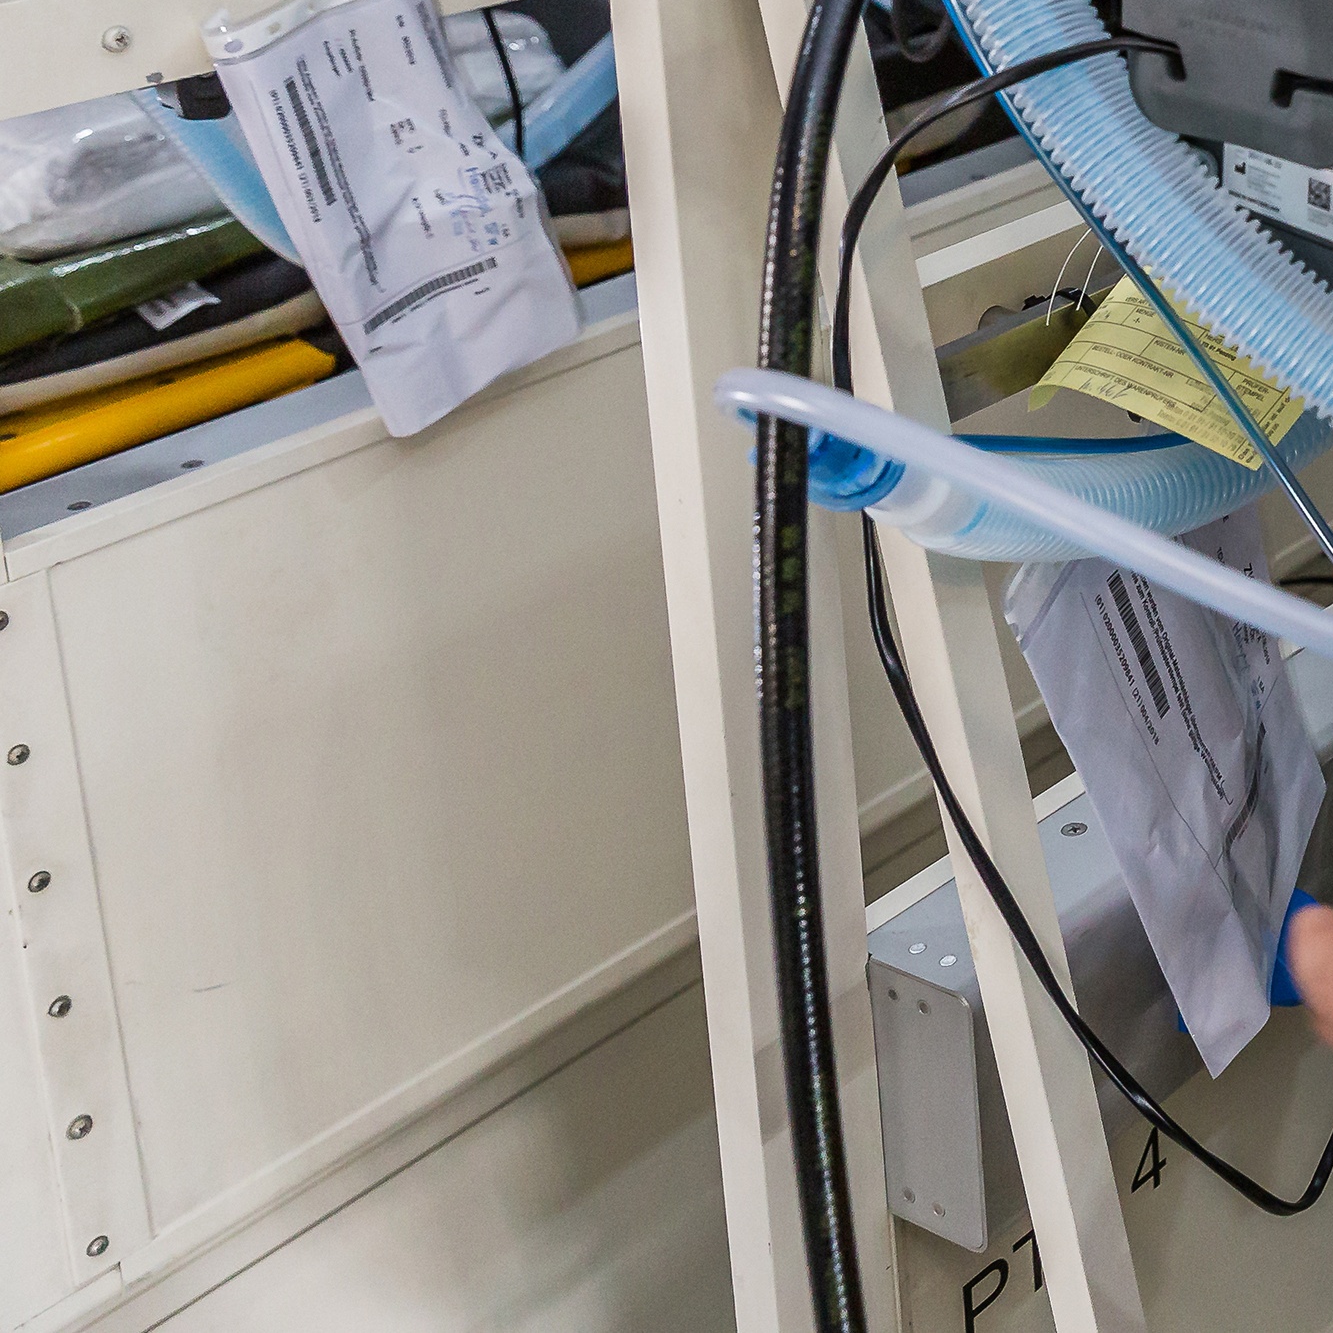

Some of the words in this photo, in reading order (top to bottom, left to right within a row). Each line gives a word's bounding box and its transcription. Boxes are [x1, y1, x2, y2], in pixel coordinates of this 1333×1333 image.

[1132, 355, 1175, 379] KONTRAKT-NR
[1114, 376, 1127, 388] DES
[1134, 584, 1145, 600] zum
[1143, 590, 1160, 616] wurden
[1154, 616, 1165, 632] vom
[1131, 1126, 1167, 1194] 4
